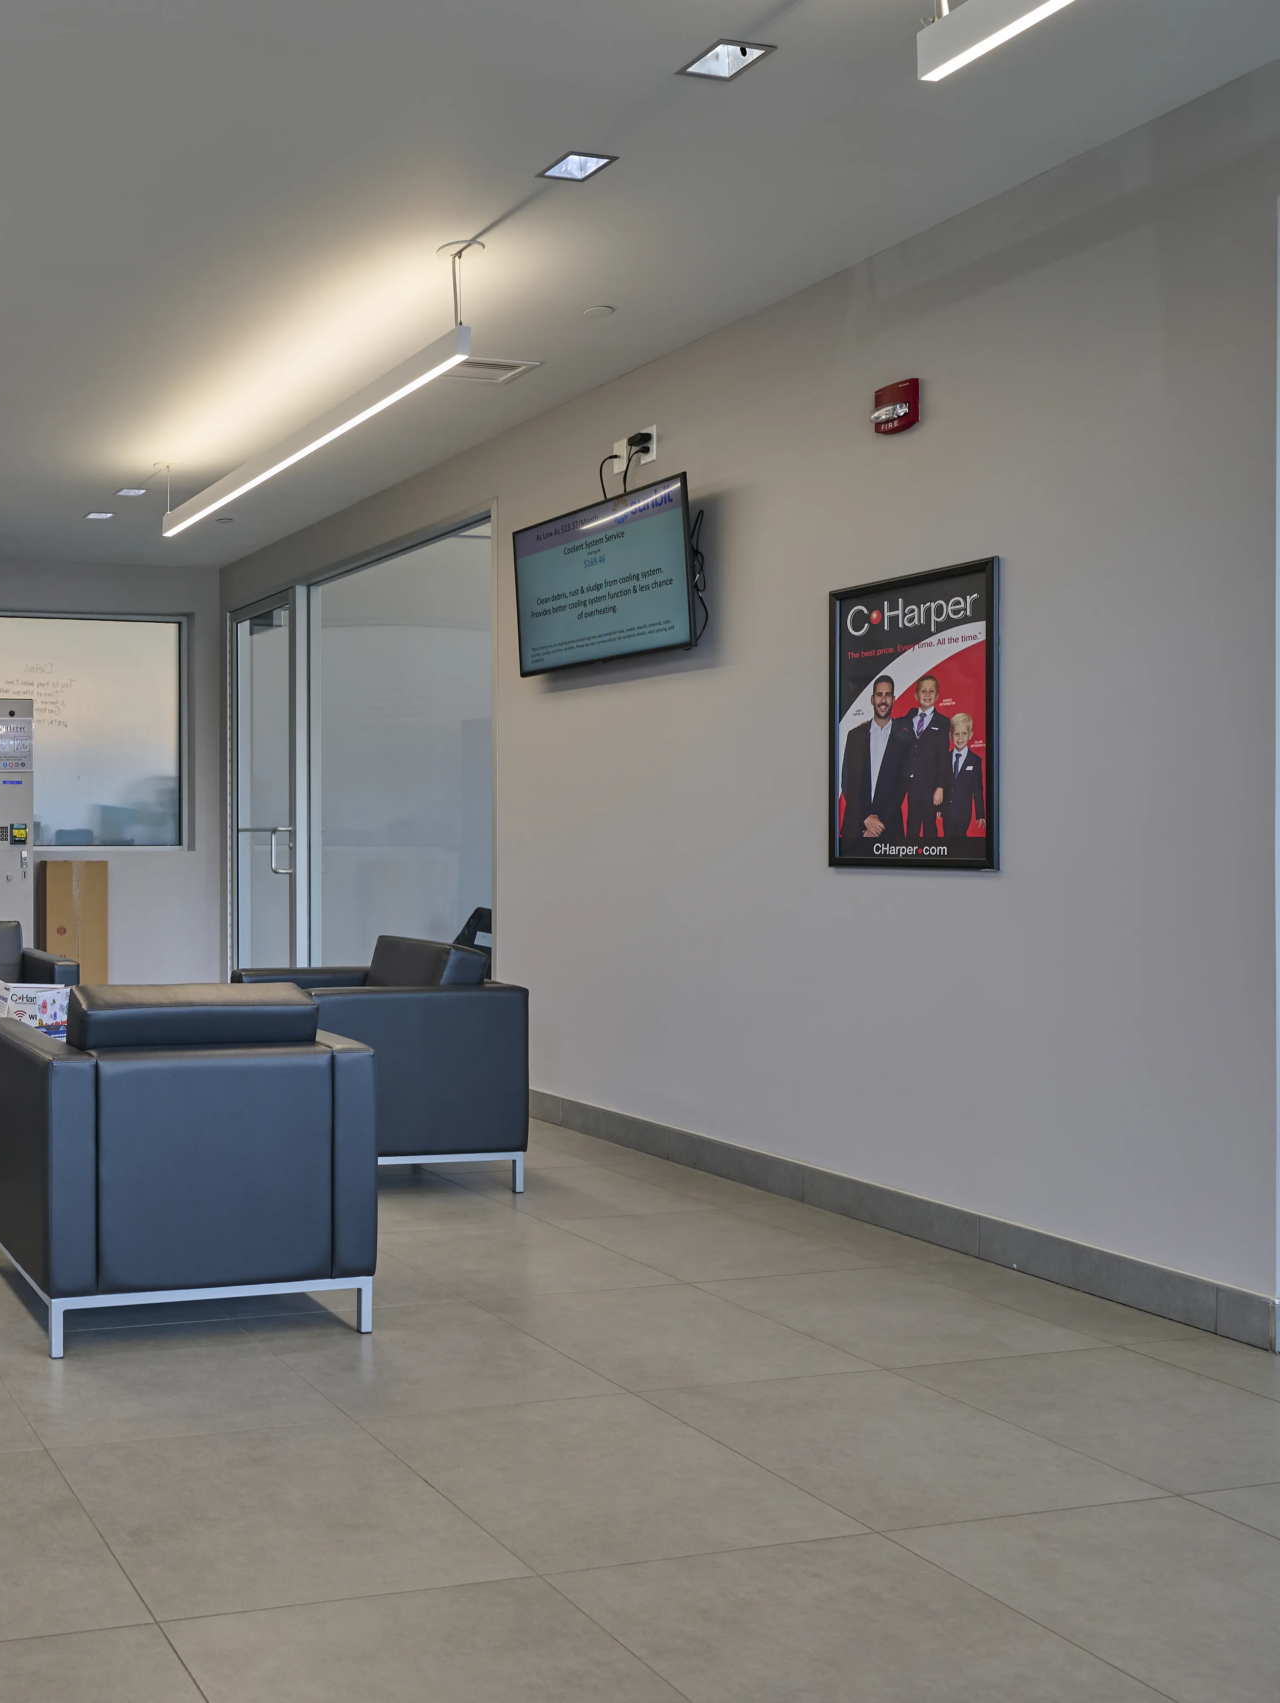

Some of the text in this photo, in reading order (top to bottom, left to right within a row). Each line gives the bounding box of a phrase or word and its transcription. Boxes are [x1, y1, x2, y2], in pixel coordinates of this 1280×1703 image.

[881, 420, 898, 430] FIRE
[564, 532, 624, 555] Coolant System Service
[537, 568, 663, 605] Clean debris, rust & sludge from cooling system.
[531, 578, 673, 618] Provides better cooling system function & less chance
[578, 606, 616, 620] of overheating.
[861, 650, 876, 658] best
[877, 647, 895, 656] price.
[897, 644, 916, 652] Every
[936, 638, 946, 646] All
[948, 636, 959, 644] the
